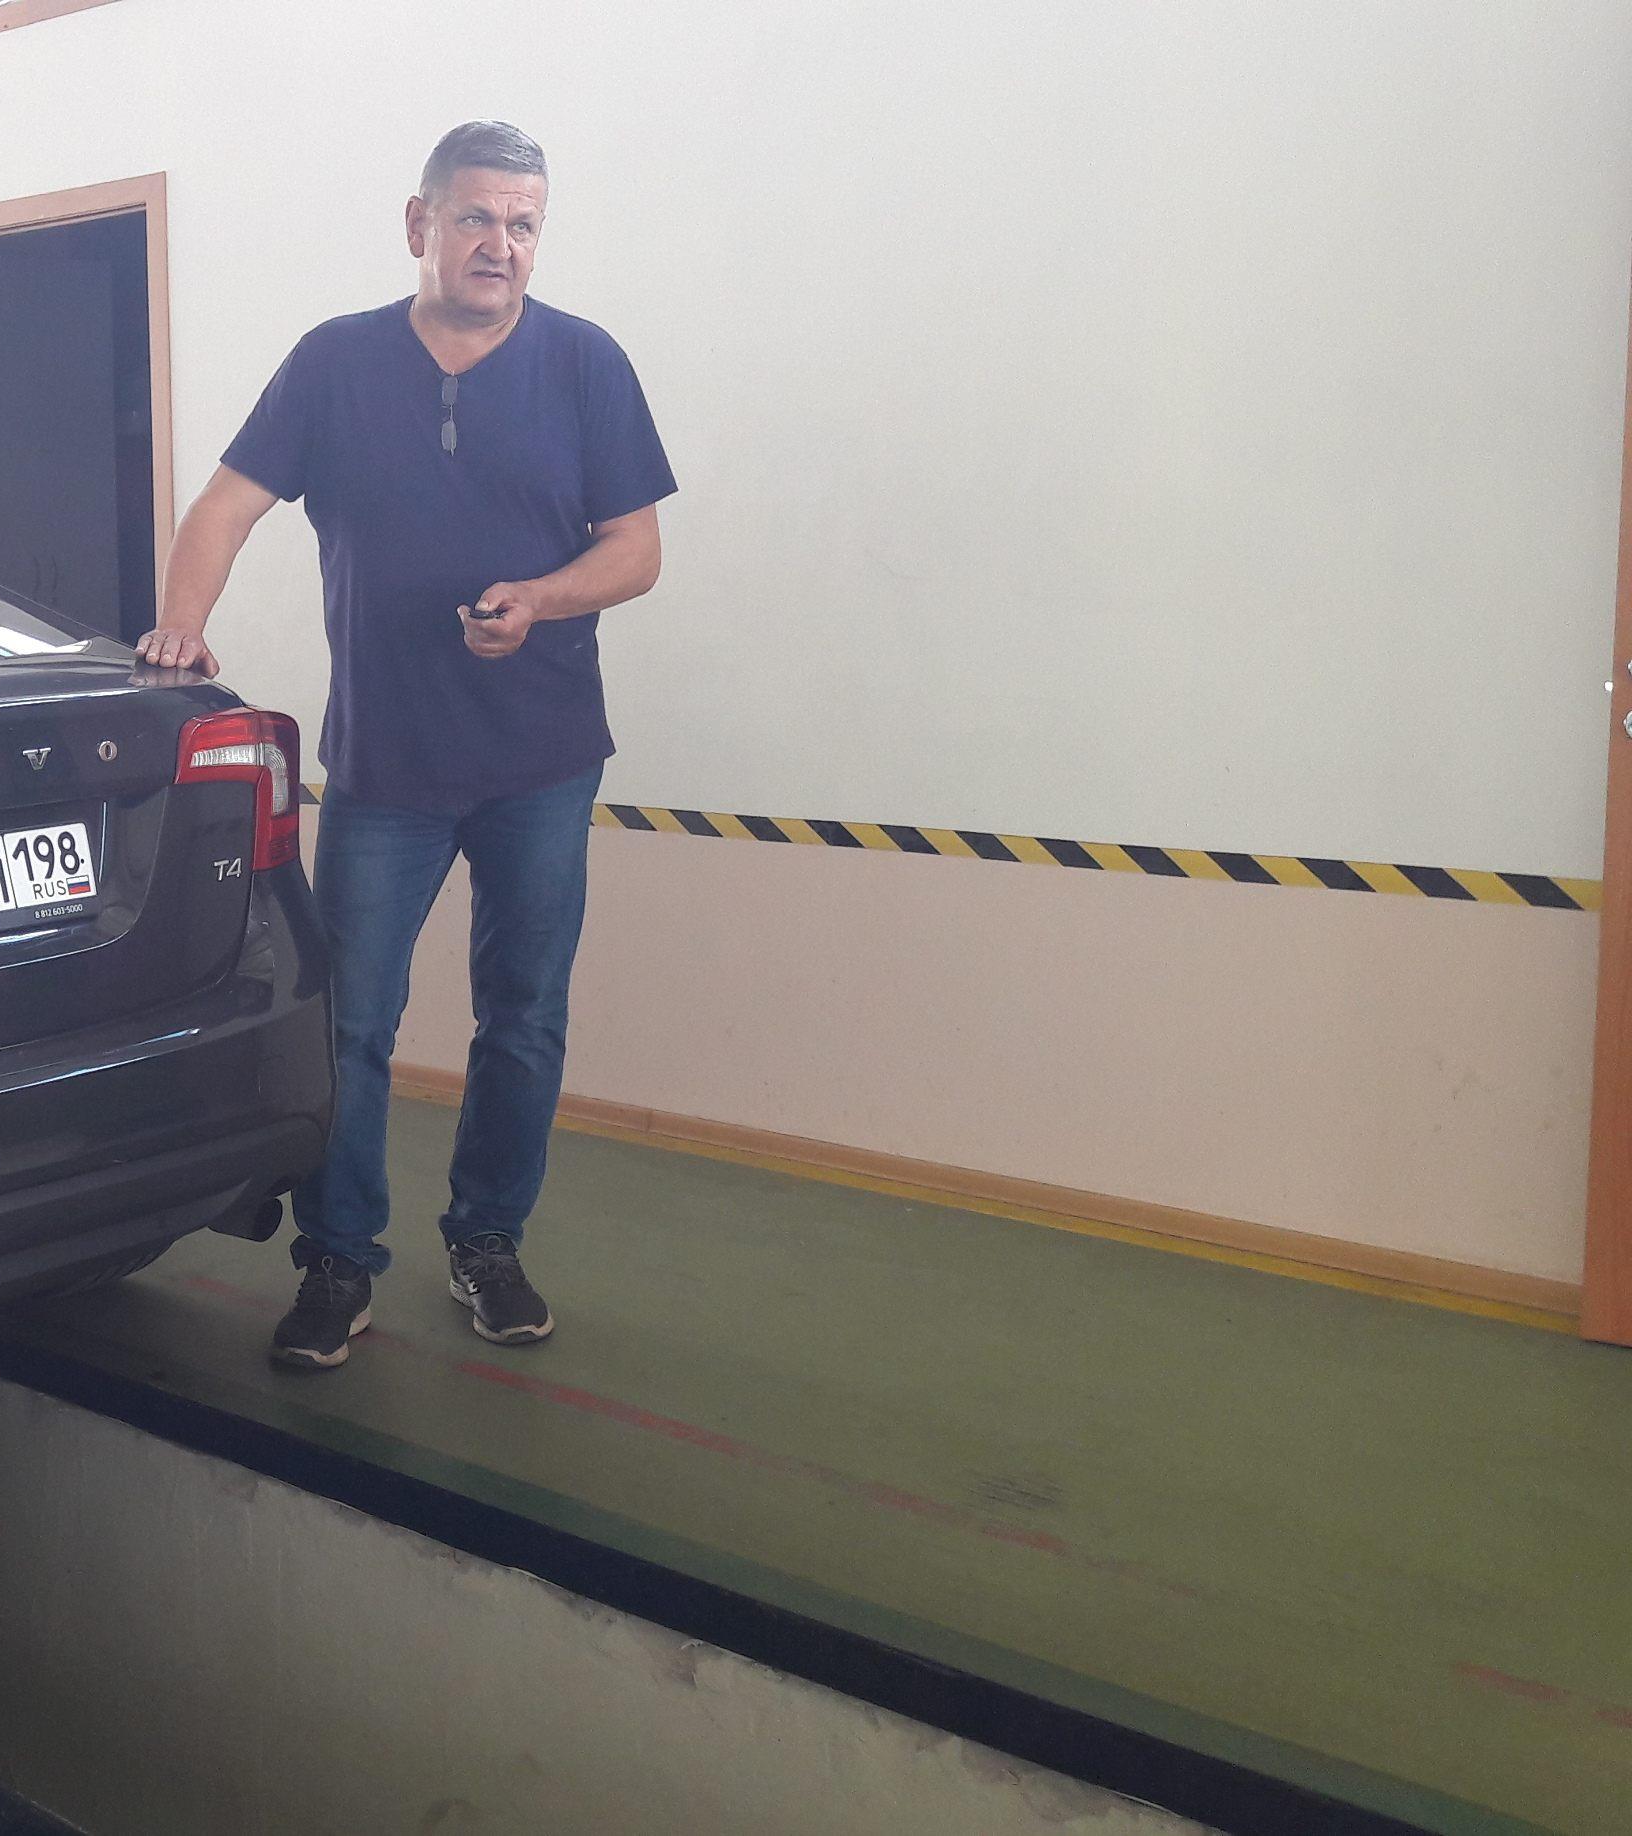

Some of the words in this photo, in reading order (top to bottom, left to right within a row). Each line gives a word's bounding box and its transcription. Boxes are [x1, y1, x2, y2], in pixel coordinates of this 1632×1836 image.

[11, 831, 81, 882] 198
[214, 858, 241, 881] T4
[32, 880, 66, 899] RUS
